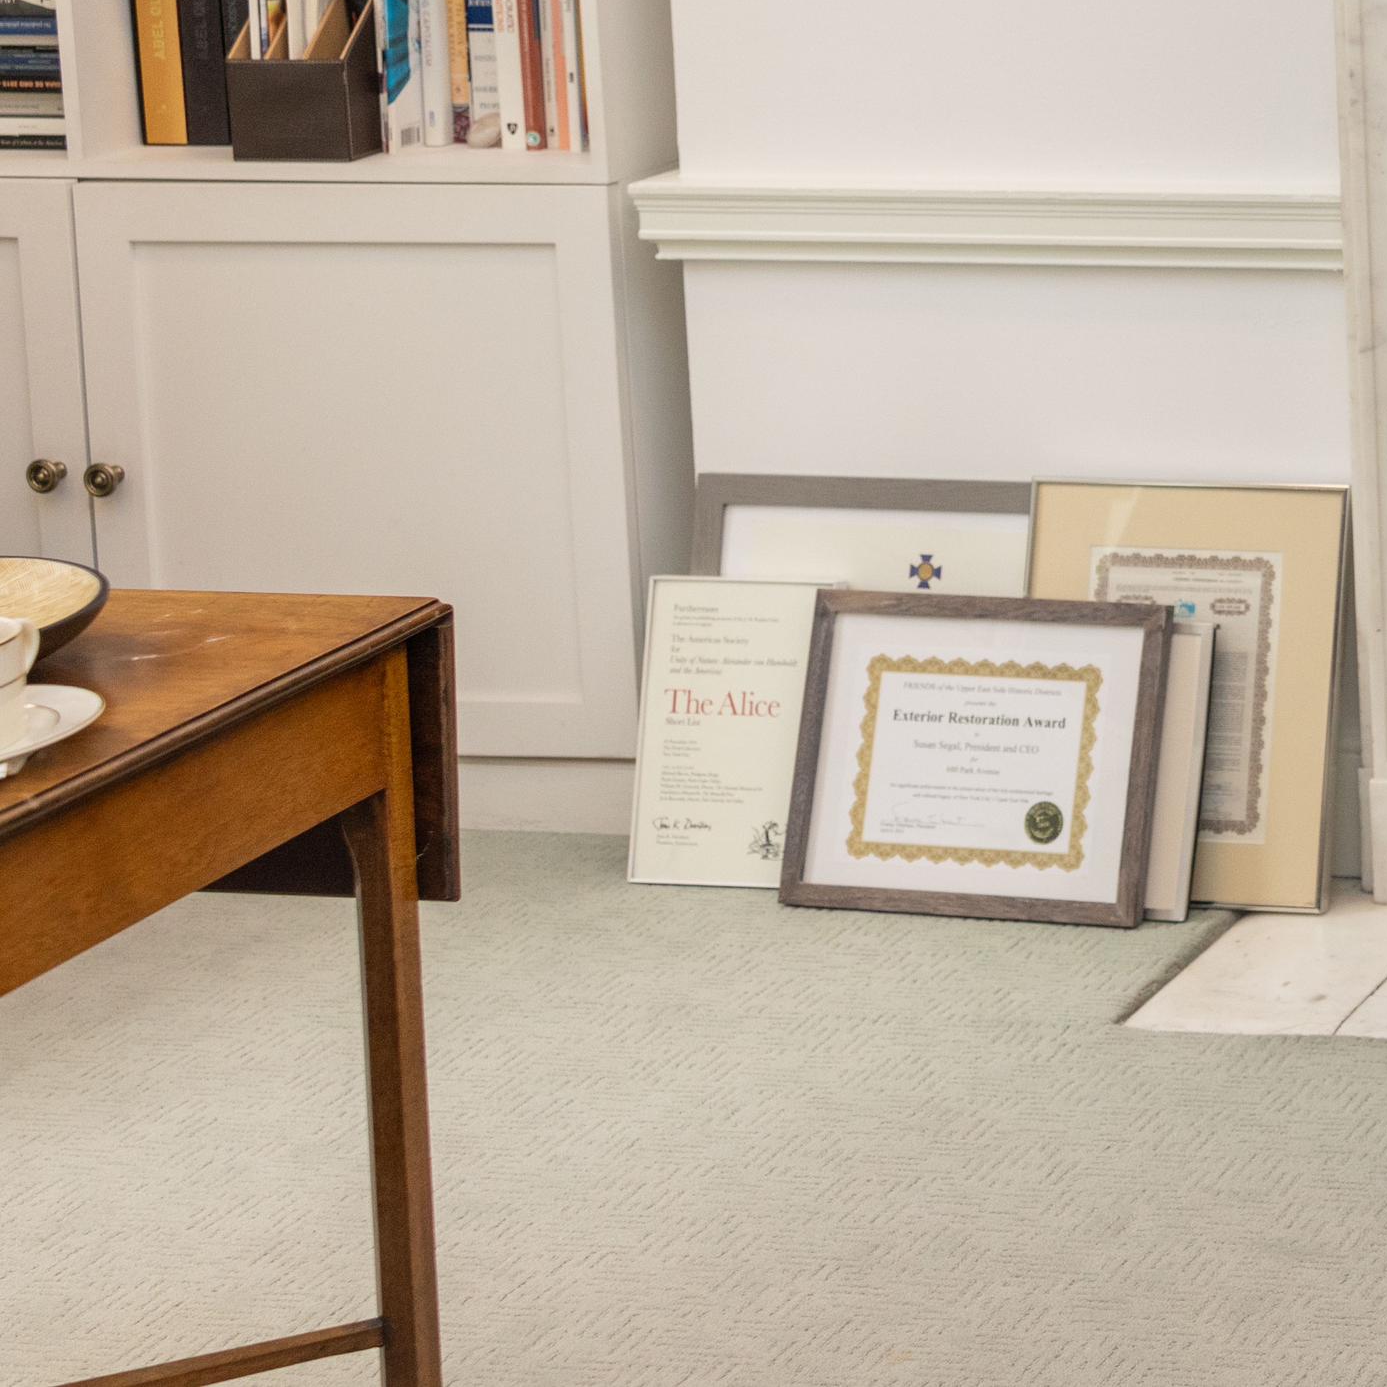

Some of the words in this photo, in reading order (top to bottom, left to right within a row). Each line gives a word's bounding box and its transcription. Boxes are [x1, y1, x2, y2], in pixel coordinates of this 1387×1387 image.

[152, 21, 166, 61] ABEL
[956, 684, 976, 693] Upper
[664, 688, 713, 714] The
[718, 690, 781, 718] Alice
[893, 709, 943, 724] Exterior
[948, 711, 1020, 728] Restoration
[1023, 716, 1067, 730] Award
[914, 739, 937, 750] Susan
[939, 740, 962, 752] Segal,
[965, 742, 1001, 754] President
[1002, 744, 1017, 754] and
[1019, 744, 1040, 755] CEO
